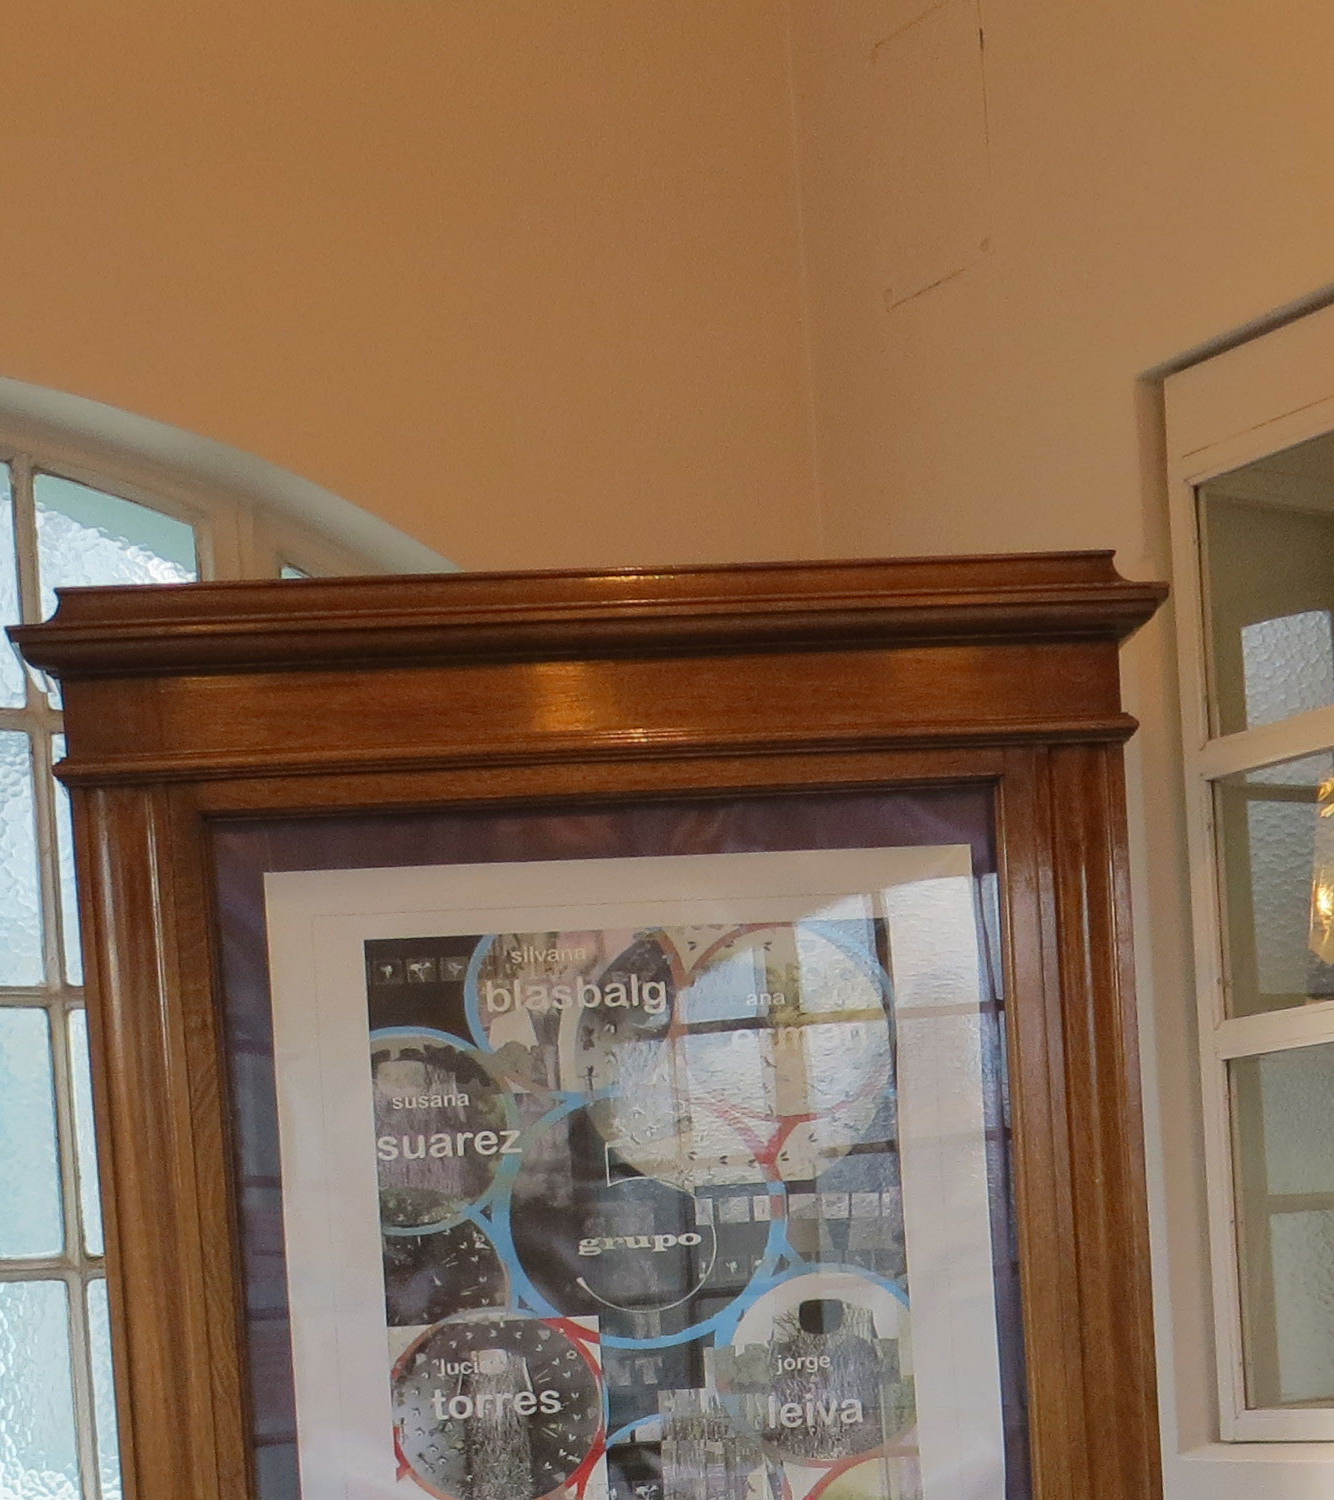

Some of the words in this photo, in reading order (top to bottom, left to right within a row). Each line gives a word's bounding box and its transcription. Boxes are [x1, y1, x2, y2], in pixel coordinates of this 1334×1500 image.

[511, 946, 586, 964] silvana
[486, 973, 668, 1014] blasbalg
[745, 991, 786, 1007] ana
[391, 1092, 470, 1110] susana
[377, 1130, 523, 1161] suarez
[578, 1232, 702, 1256] grupo
[776, 1354, 831, 1375] jorge
[431, 1388, 563, 1421] torres
[768, 1394, 864, 1429] leiva
